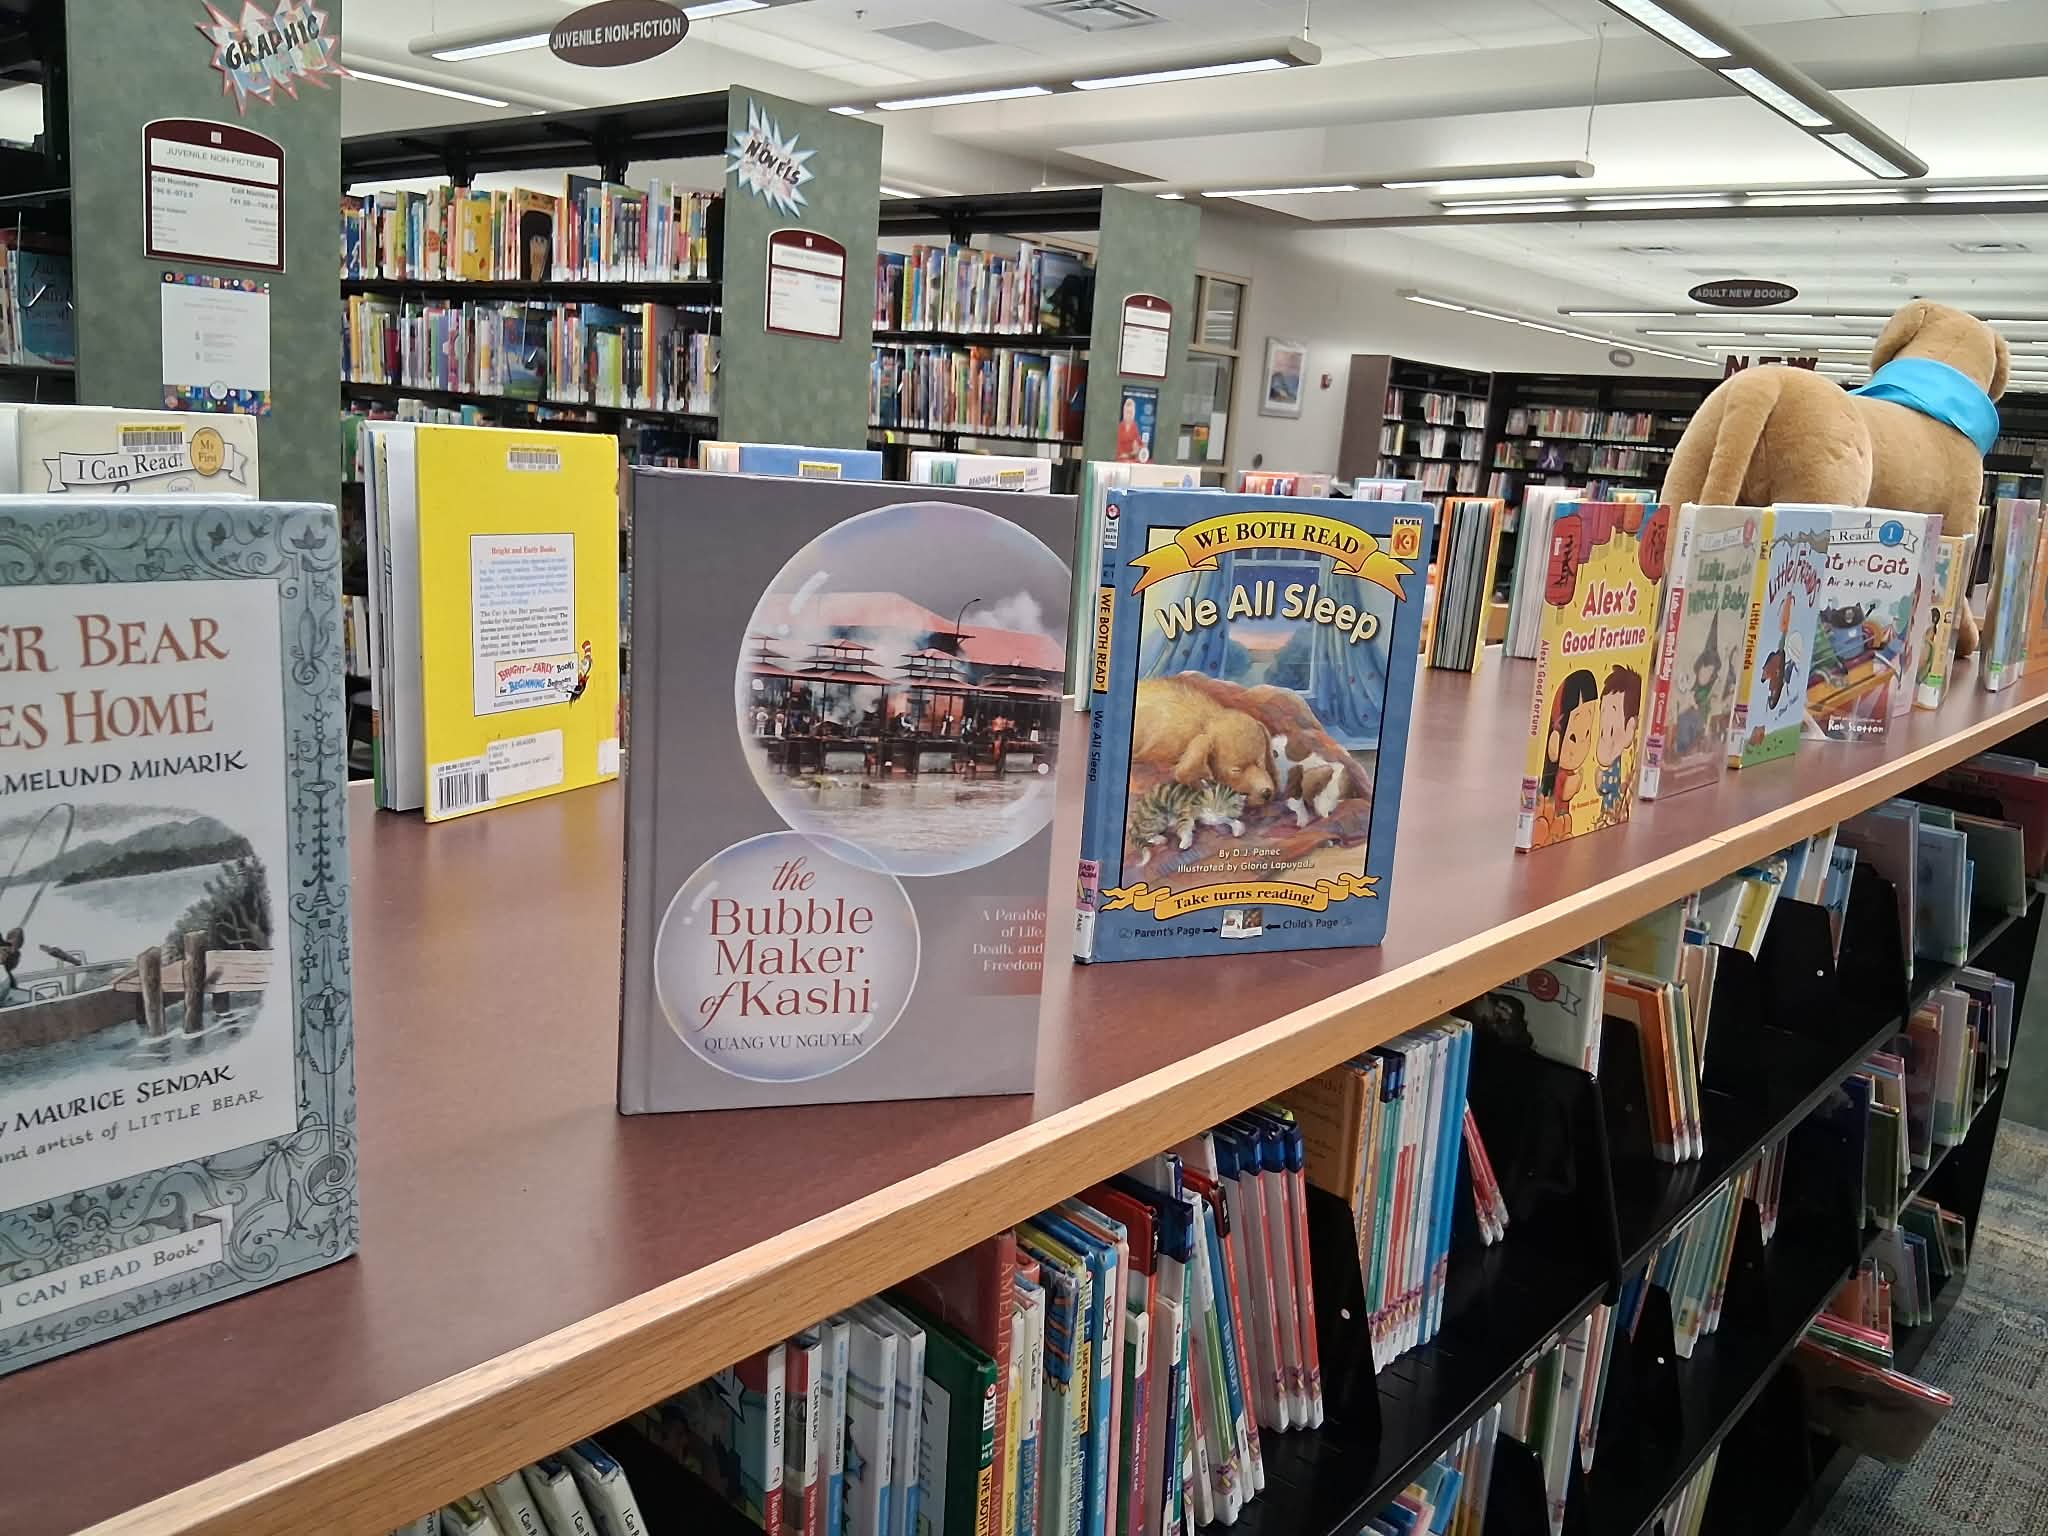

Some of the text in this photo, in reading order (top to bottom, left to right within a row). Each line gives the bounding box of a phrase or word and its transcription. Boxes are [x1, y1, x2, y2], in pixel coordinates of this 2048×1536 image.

[225, 15, 320, 70] GRAPHIC
[553, 17, 681, 50] JUVENILE NON-FICTION
[167, 147, 208, 161] JUVENILE
[744, 139, 801, 185] NOVELS
[1695, 288, 1791, 299] ADULT NEW BOOKS
[90, 458, 129, 481] Can
[133, 453, 183, 475] Read!
[1193, 521, 1359, 555] WE BOTH READ
[1888, 527, 1894, 540] 1
[1867, 553, 1910, 576] Cat
[1102, 593, 1112, 615] WE
[1154, 579, 1380, 645] We All Sleep
[1581, 580, 1638, 618] Alex's
[73, 613, 231, 669] BEAR
[1097, 617, 1110, 650] BOTH
[1562, 626, 1646, 654] Good Fortune
[1095, 651, 1107, 685] READ
[1536, 670, 1546, 696] Good
[56, 689, 215, 746] HOME
[1530, 697, 1543, 736] Fortune
[1088, 710, 1104, 783] We All Sleep
[0, 750, 249, 797] MELUND MINARIK
[1177, 863, 1225, 873] Illustrated
[1227, 862, 1238, 872] by
[1241, 861, 1268, 871] Gloria
[1219, 848, 1281, 859] By Panec
[770, 856, 817, 892] the
[995, 908, 1046, 921] Parable
[1175, 888, 1315, 909] Take turns reading!
[709, 898, 873, 935] Bubble
[1001, 926, 1016, 937] of
[1134, 926, 1201, 938] Parent's Page
[1316, 918, 1339, 929] Page
[714, 938, 865, 976] Maker
[983, 959, 1042, 971] Freedom
[1018, 943, 1043, 955] and
[692, 978, 873, 1033] of Kashi
[704, 1031, 864, 1054] QUANG VU NGUYEN
[13, 1088, 126, 1132] MAURICE
[136, 1065, 236, 1104] SENDAK
[36, 1129, 94, 1155] artist
[101, 1121, 118, 1141] of
[127, 1103, 202, 1132] LITTLE
[211, 1088, 265, 1112] BEAR
[15, 1280, 71, 1307] CAN
[79, 1259, 141, 1290] READ
[773, 1391, 781, 1416] CAN
[980, 1471, 991, 1494] WE
[978, 1496, 990, 1530] BOTH
